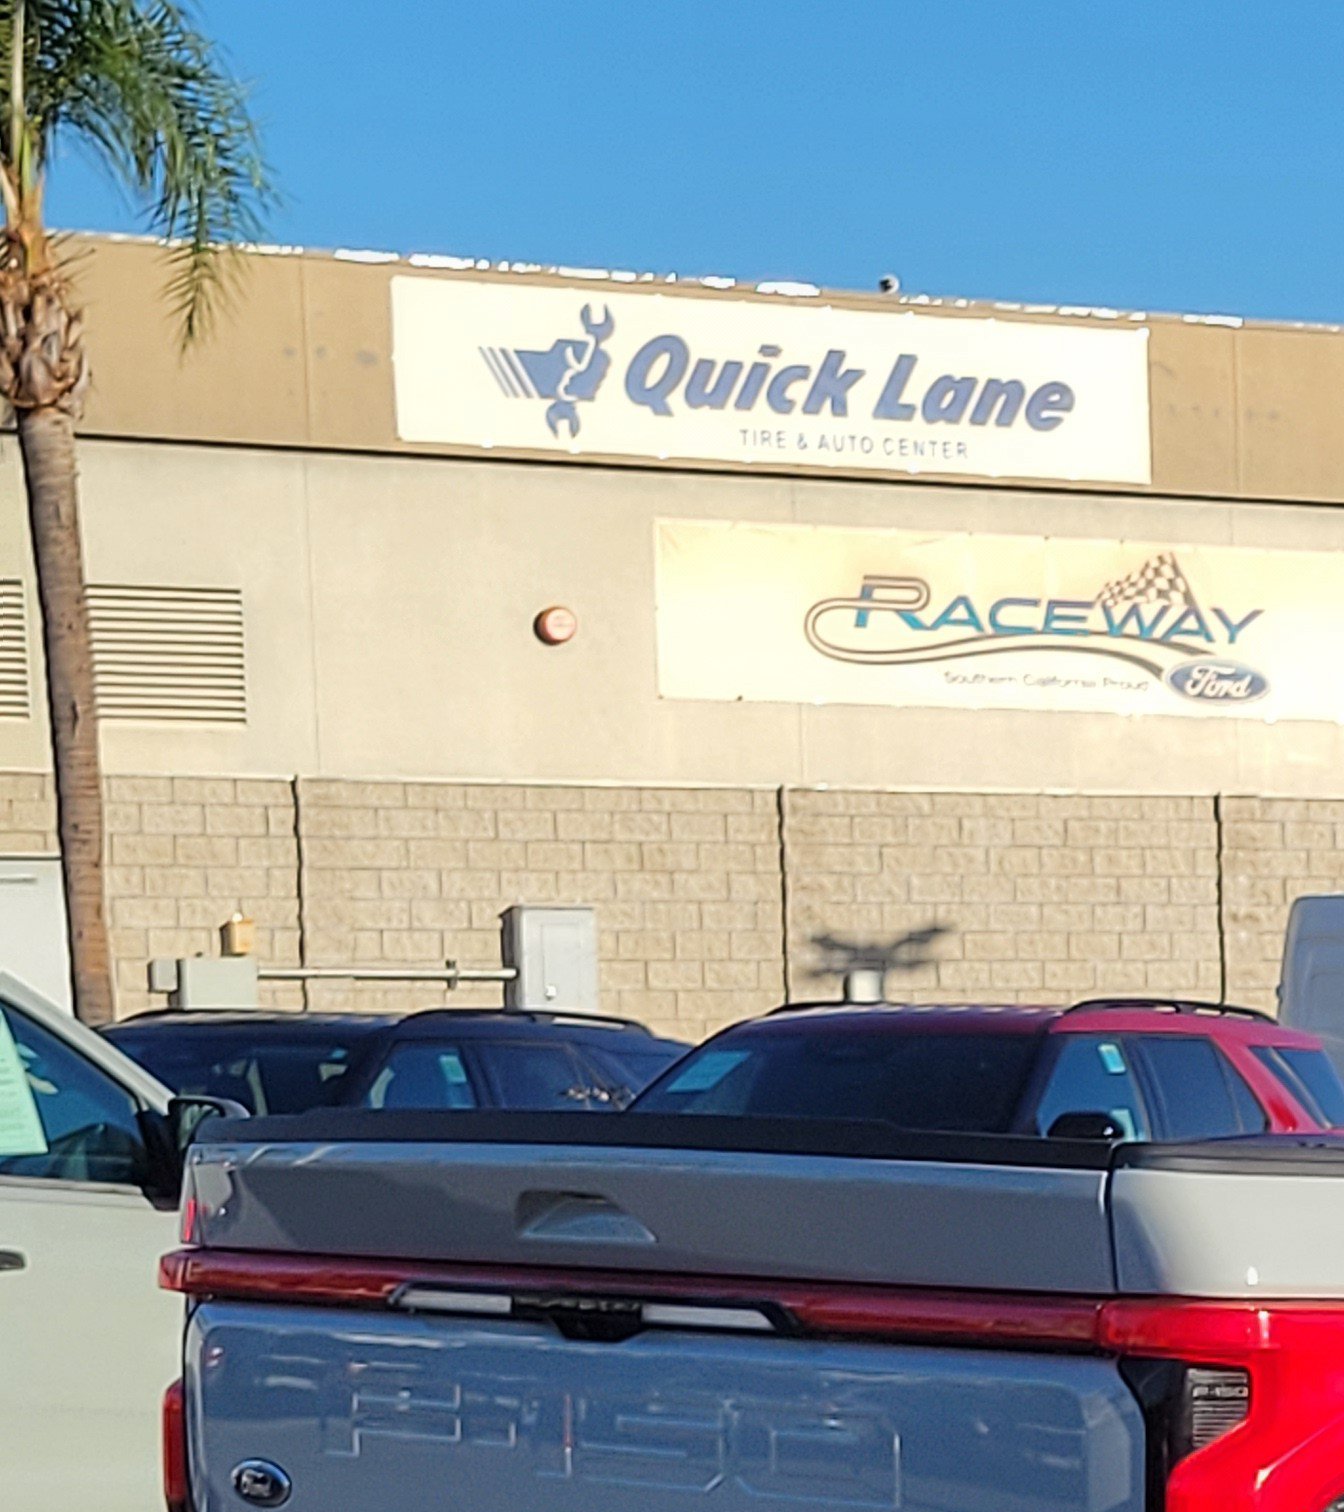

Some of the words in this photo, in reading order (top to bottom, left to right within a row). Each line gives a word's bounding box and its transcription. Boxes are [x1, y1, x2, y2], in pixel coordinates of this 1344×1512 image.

[624, 334, 866, 416] Quick
[872, 354, 1075, 431] Lane
[739, 428, 787, 449] TIRE
[797, 432, 809, 450] &
[817, 433, 875, 455] AUTO
[883, 436, 969, 460] CENTER
[854, 574, 1265, 644] RACEWAY
[1180, 667, 1251, 698] Ford
